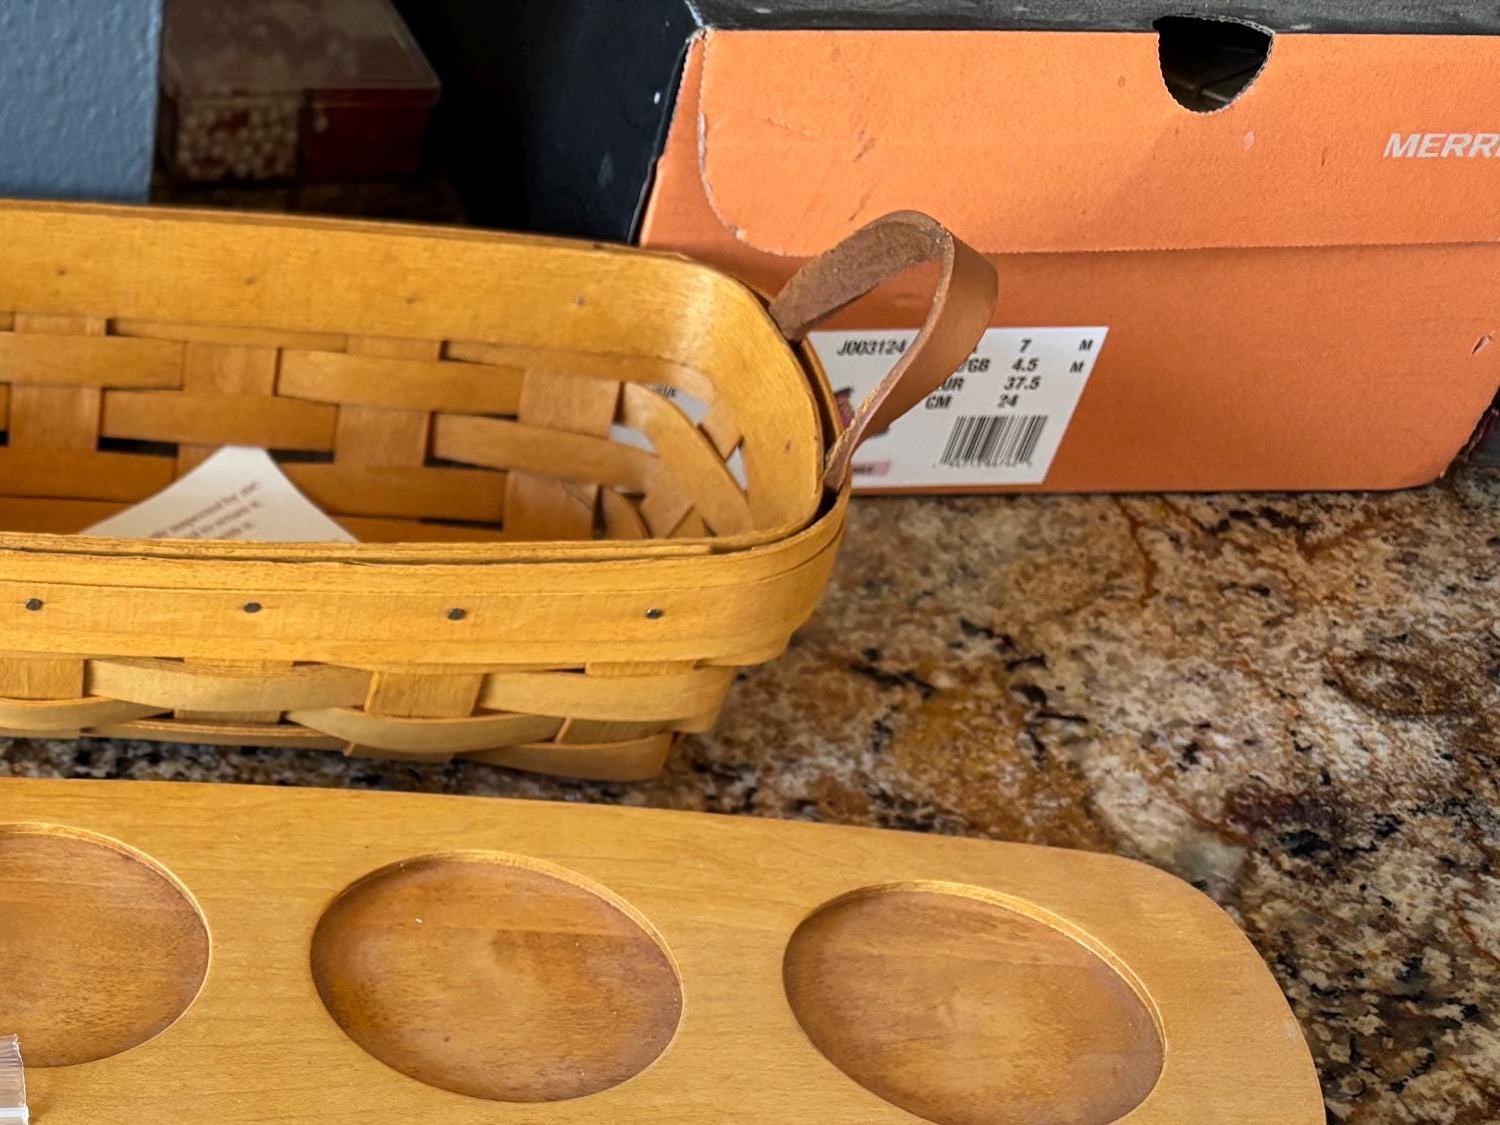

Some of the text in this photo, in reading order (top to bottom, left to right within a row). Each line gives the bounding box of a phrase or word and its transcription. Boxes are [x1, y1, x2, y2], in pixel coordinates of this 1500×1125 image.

[1382, 132, 1500, 158] MERR
[1020, 338, 1093, 352] 7 M
[1012, 357, 1039, 372] 4.5
[1069, 361, 1084, 373] M
[940, 375, 1041, 391] UR 37.5
[925, 395, 951, 409] CM
